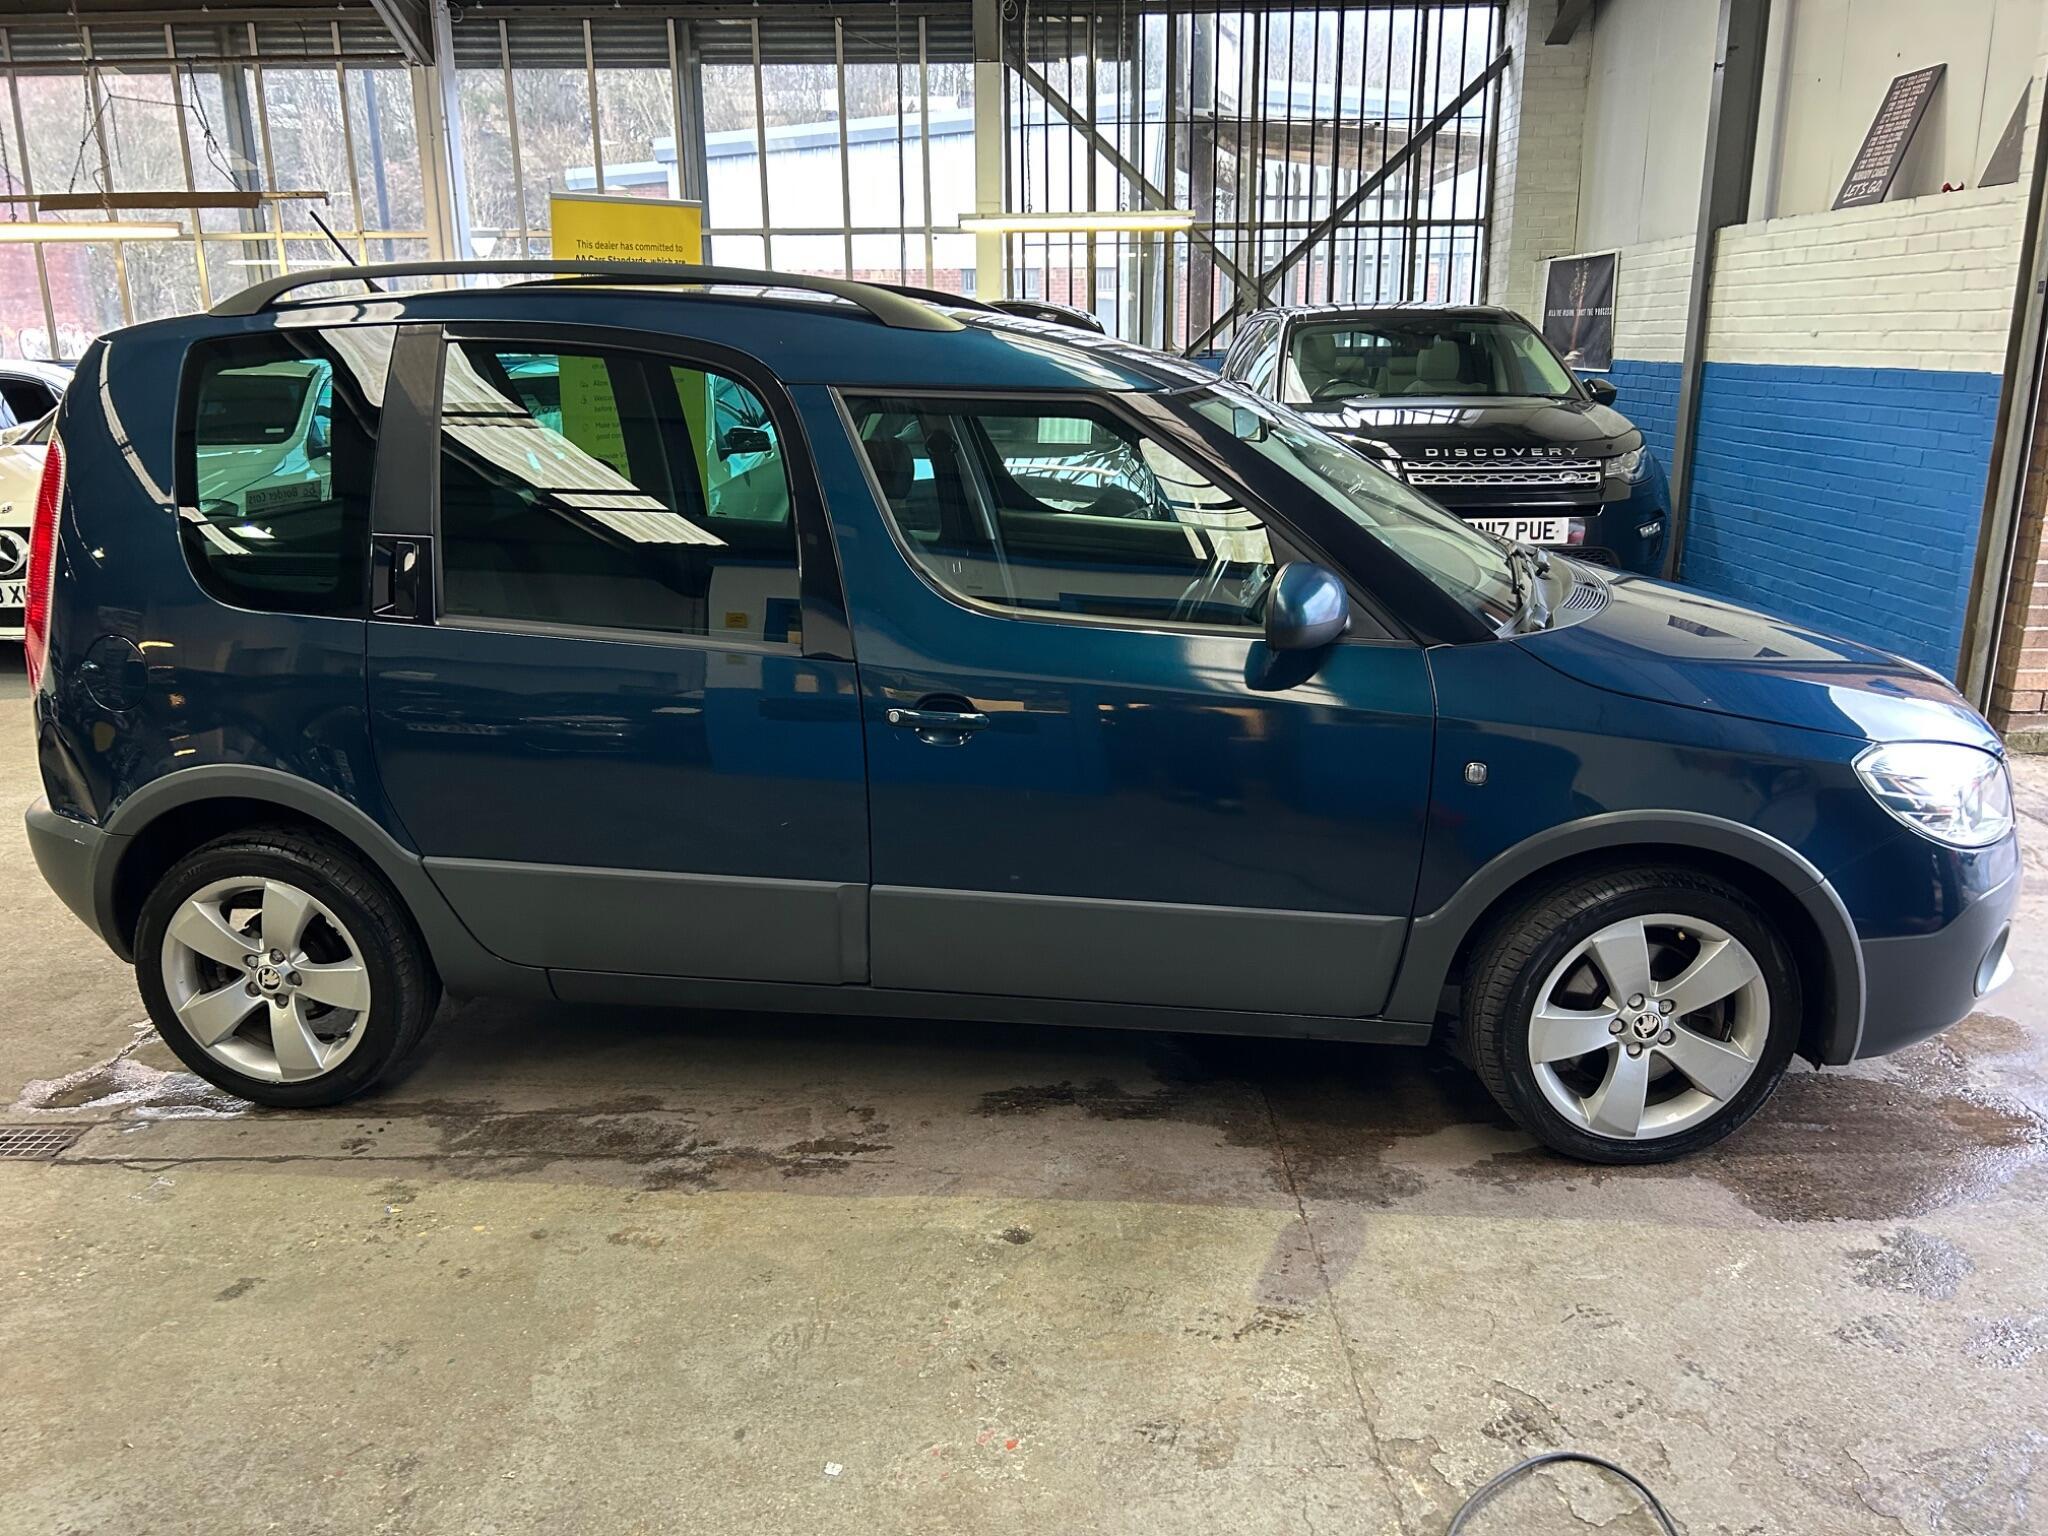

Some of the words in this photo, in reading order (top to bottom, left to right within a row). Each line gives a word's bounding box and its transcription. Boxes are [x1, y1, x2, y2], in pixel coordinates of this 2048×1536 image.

[1843, 182, 1869, 198] LET'S
[576, 240, 593, 249] This
[595, 241, 618, 250] dealer
[620, 242, 634, 251] has
[635, 244, 674, 252] committed
[1425, 447, 1579, 458] DISCOVERY
[1516, 521, 1556, 541] PUE
